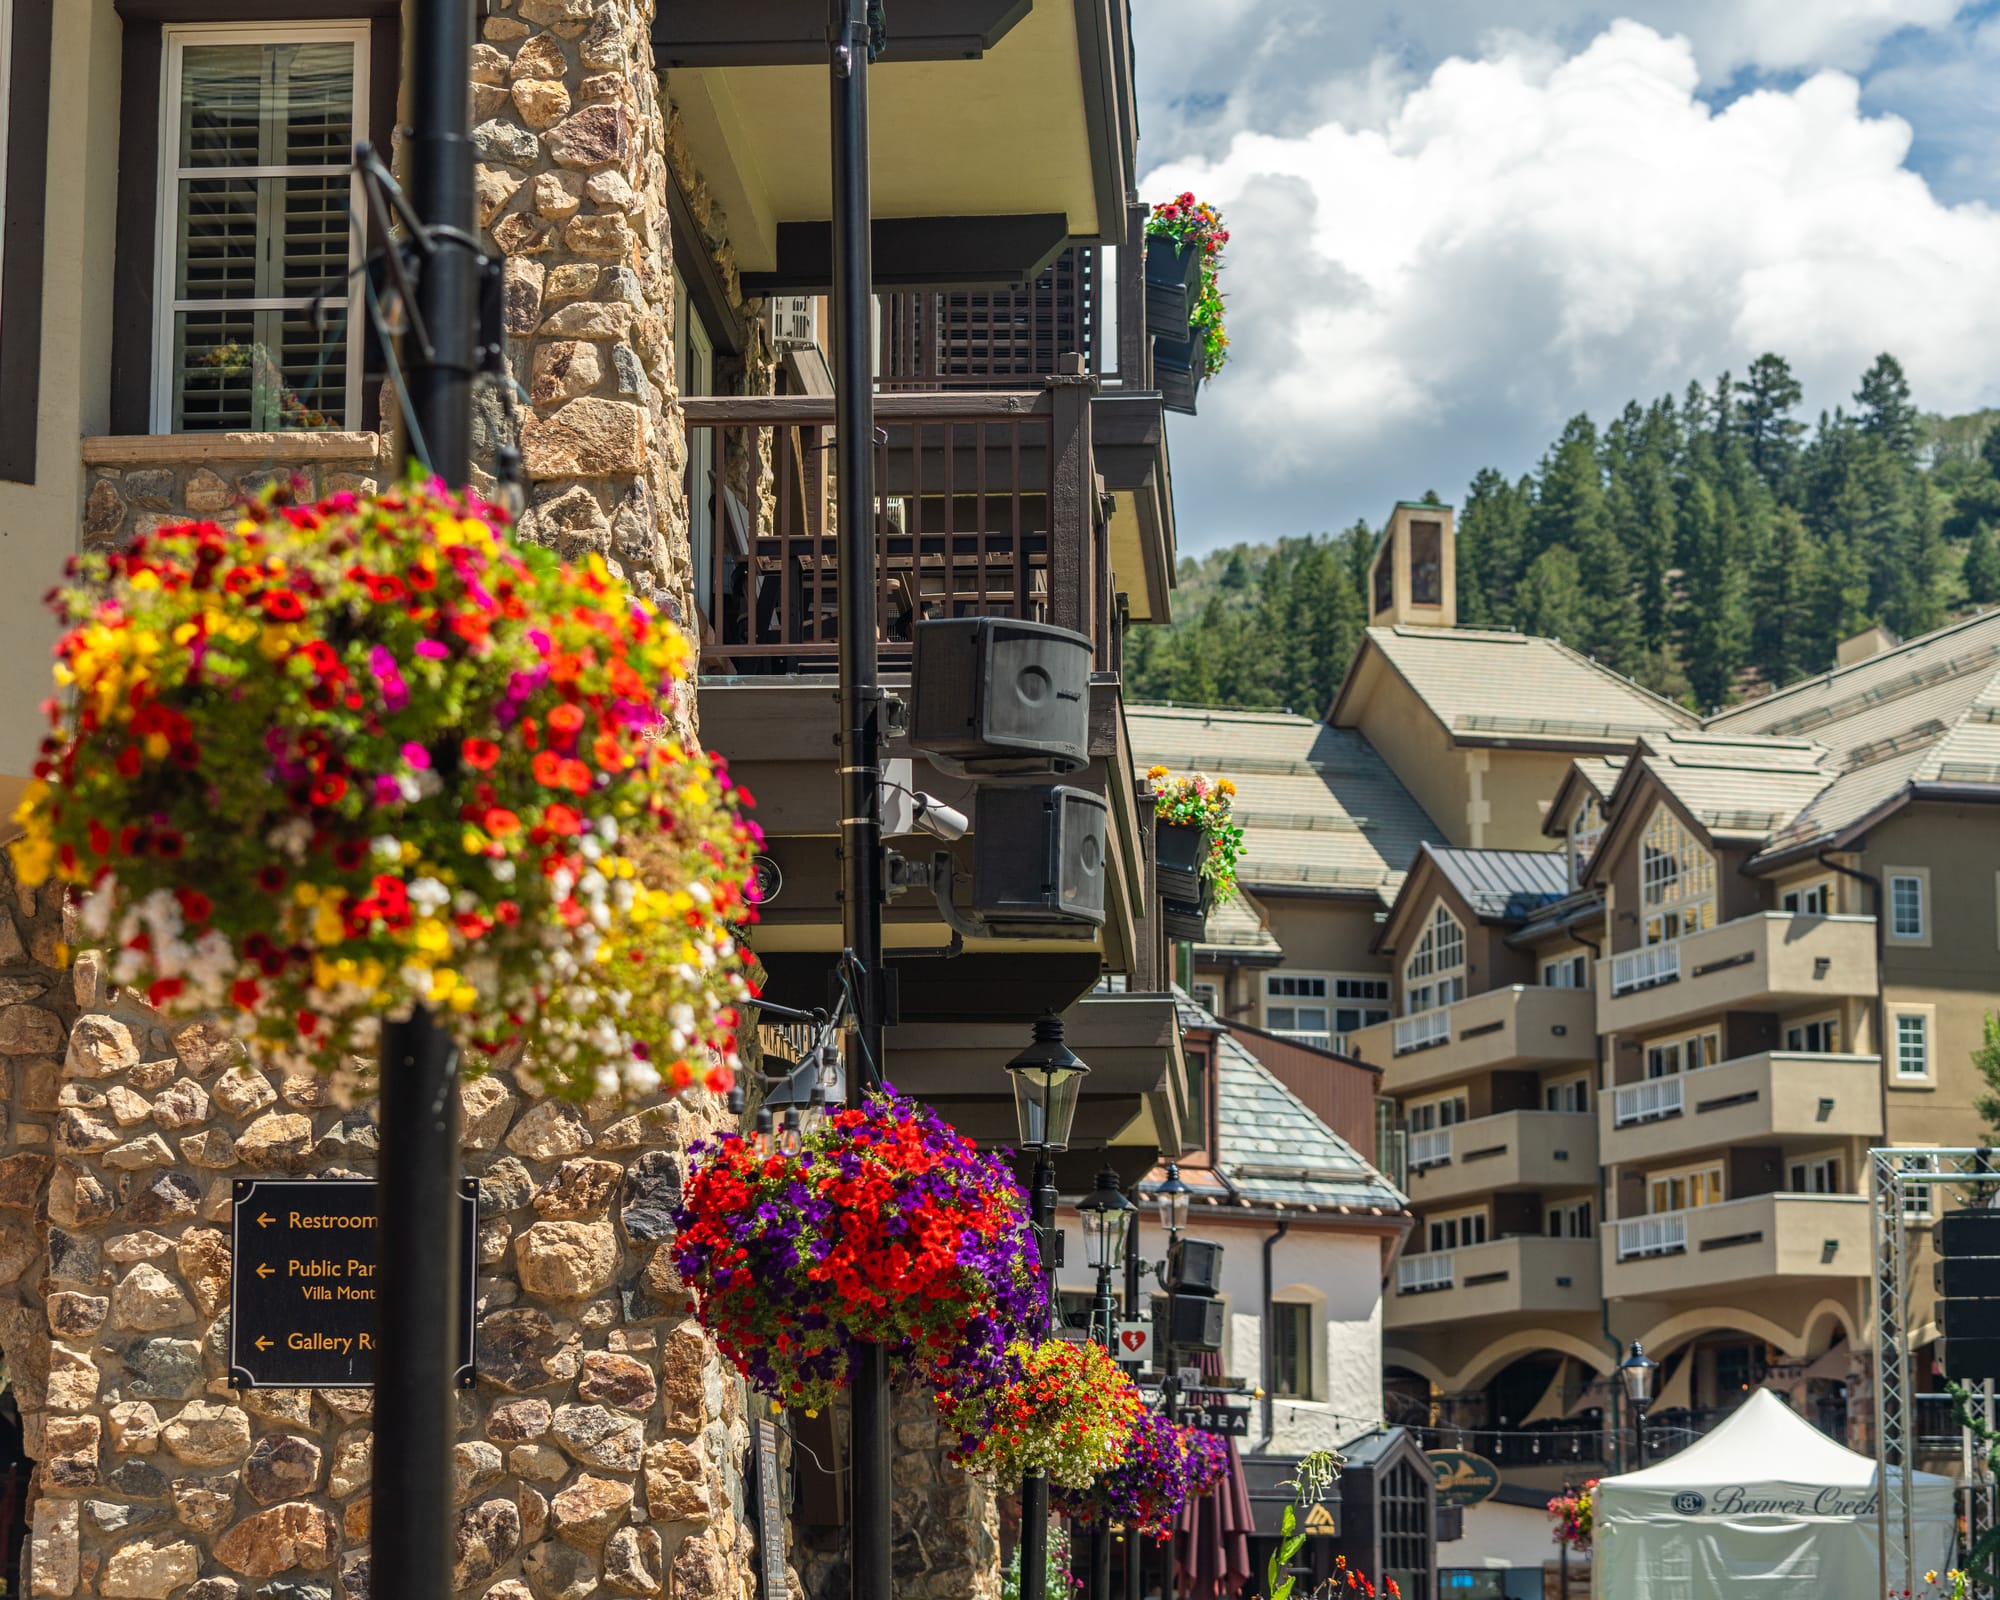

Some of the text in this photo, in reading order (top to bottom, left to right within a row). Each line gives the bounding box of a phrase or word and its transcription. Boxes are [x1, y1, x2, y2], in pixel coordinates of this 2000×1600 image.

[288, 1259, 376, 1277] Public Par
[301, 1286, 332, 1300] Villa
[287, 1332, 353, 1355] Gallery
[1711, 1486, 1808, 1515] Beaver
[1813, 1486, 1879, 1515] Creek
